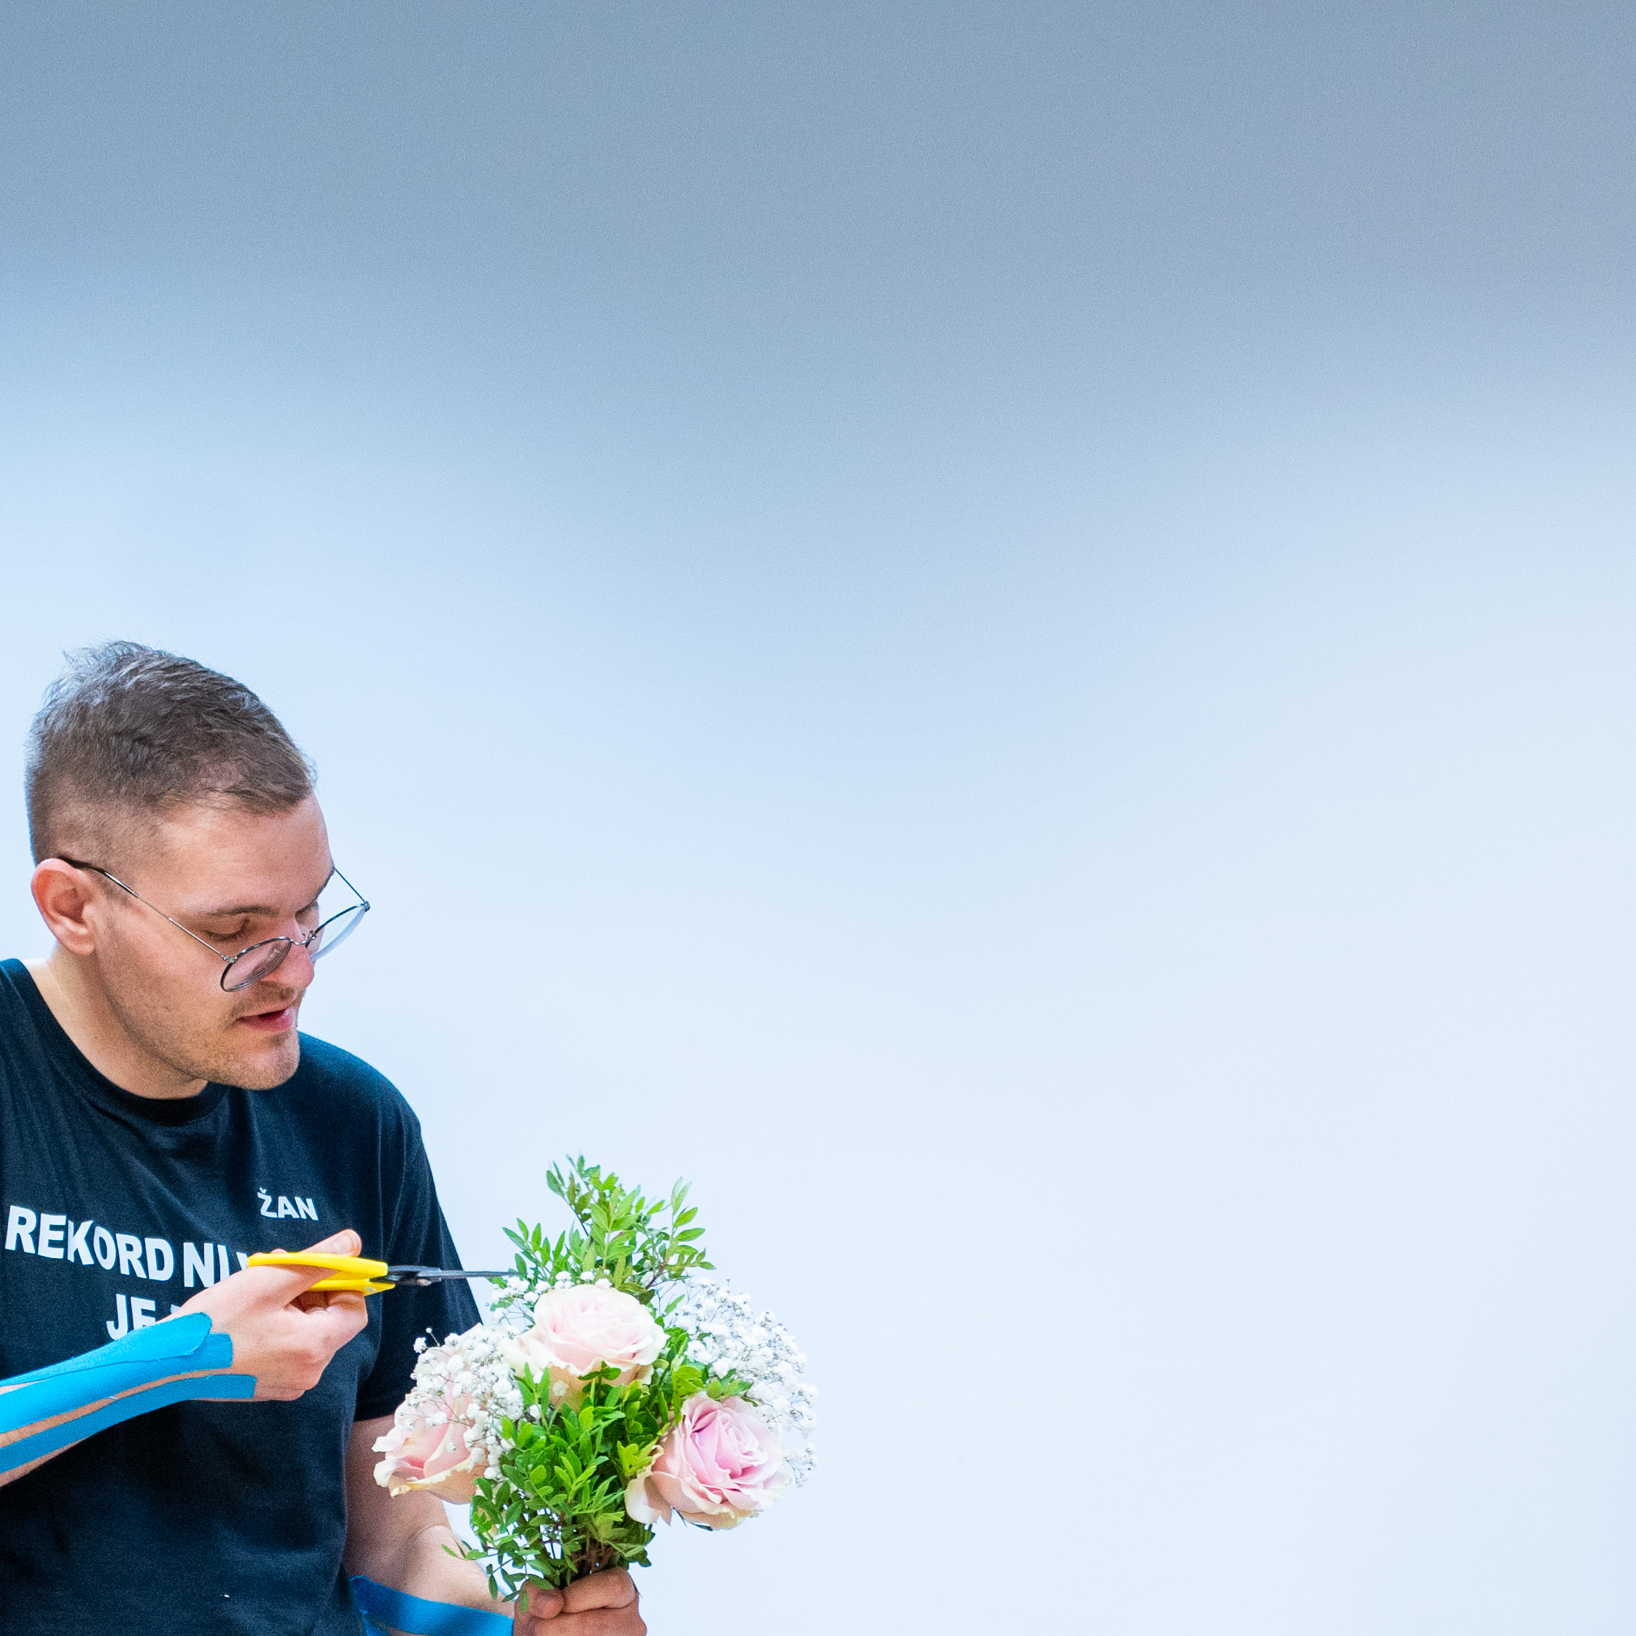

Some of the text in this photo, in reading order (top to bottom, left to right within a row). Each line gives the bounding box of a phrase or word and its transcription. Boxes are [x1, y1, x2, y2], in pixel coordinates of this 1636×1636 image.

[258, 1187, 319, 1221] ŽAN
[5, 1205, 232, 1288] REKORD NI
[106, 1294, 157, 1341] JE
